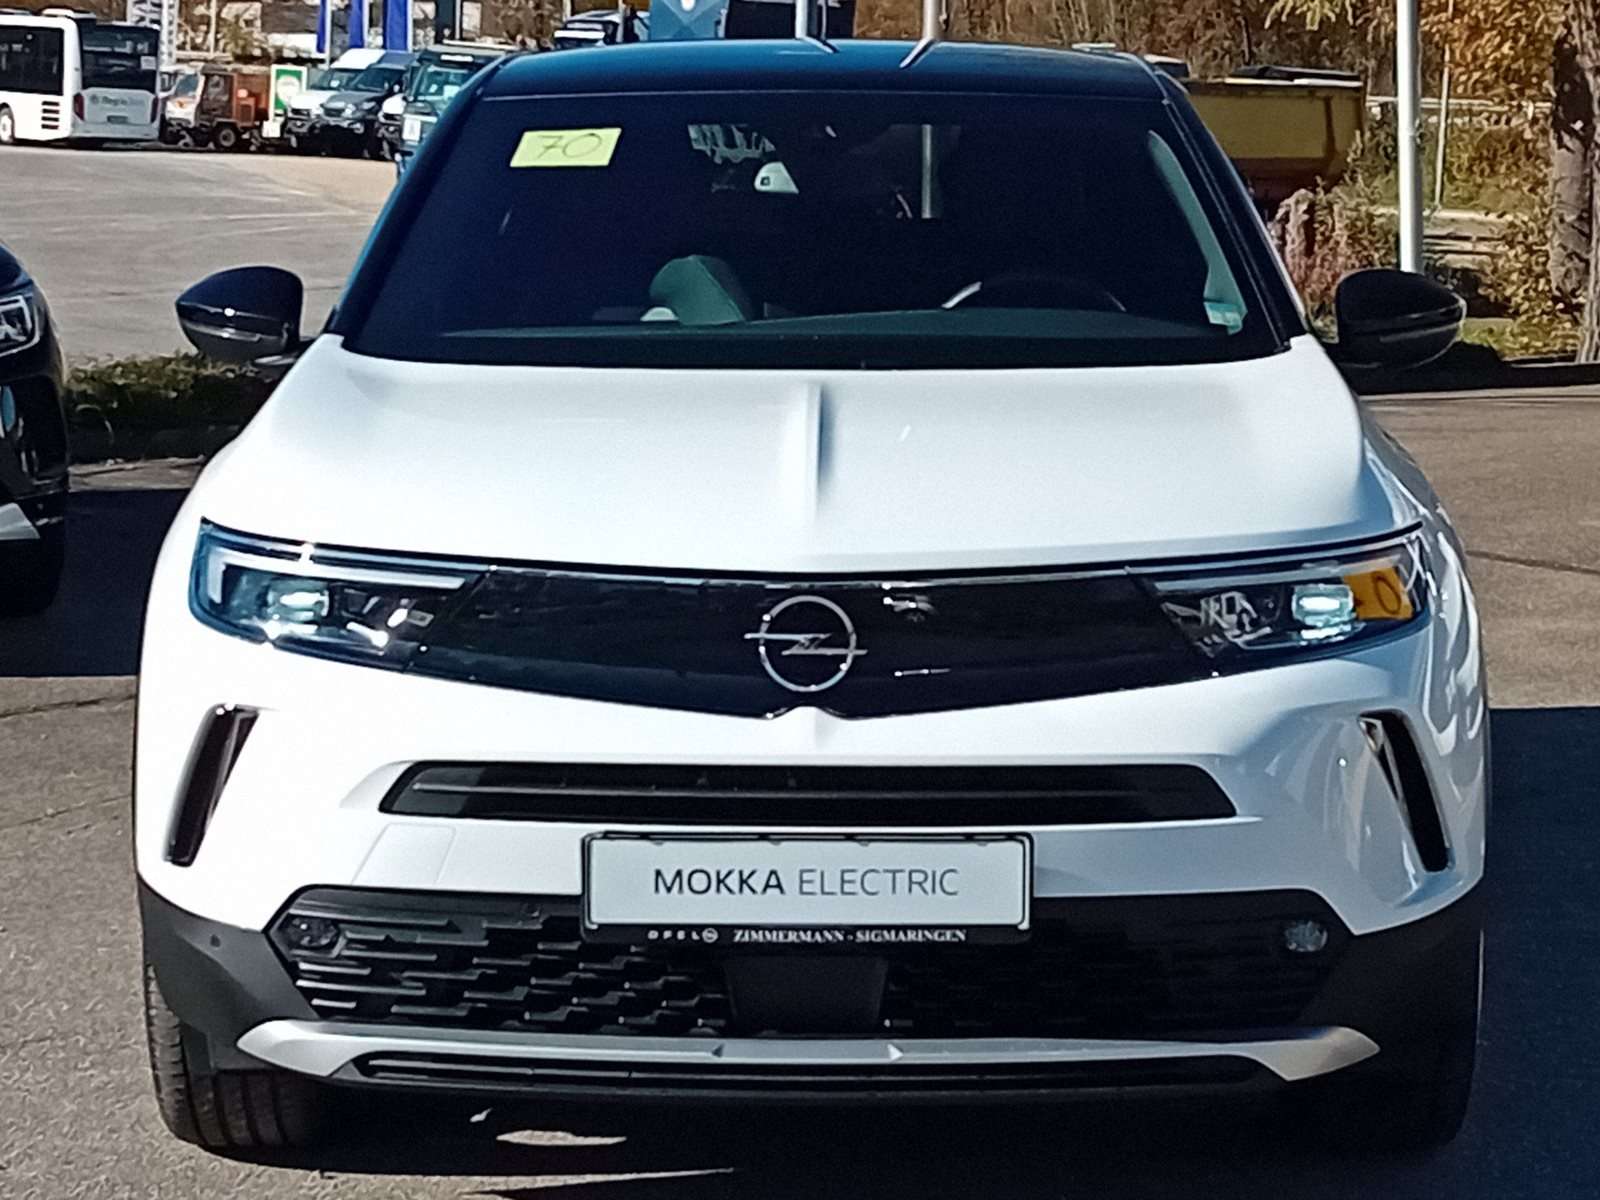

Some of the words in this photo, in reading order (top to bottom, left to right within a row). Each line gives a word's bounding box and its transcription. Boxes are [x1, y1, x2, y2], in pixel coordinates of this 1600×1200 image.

[536, 132, 603, 160] 70
[653, 868, 786, 896] MOKKA
[798, 868, 960, 896] ELECTRIC
[733, 928, 845, 943] ZIMMERMANN
[855, 928, 967, 943] SIGMARINGEN
